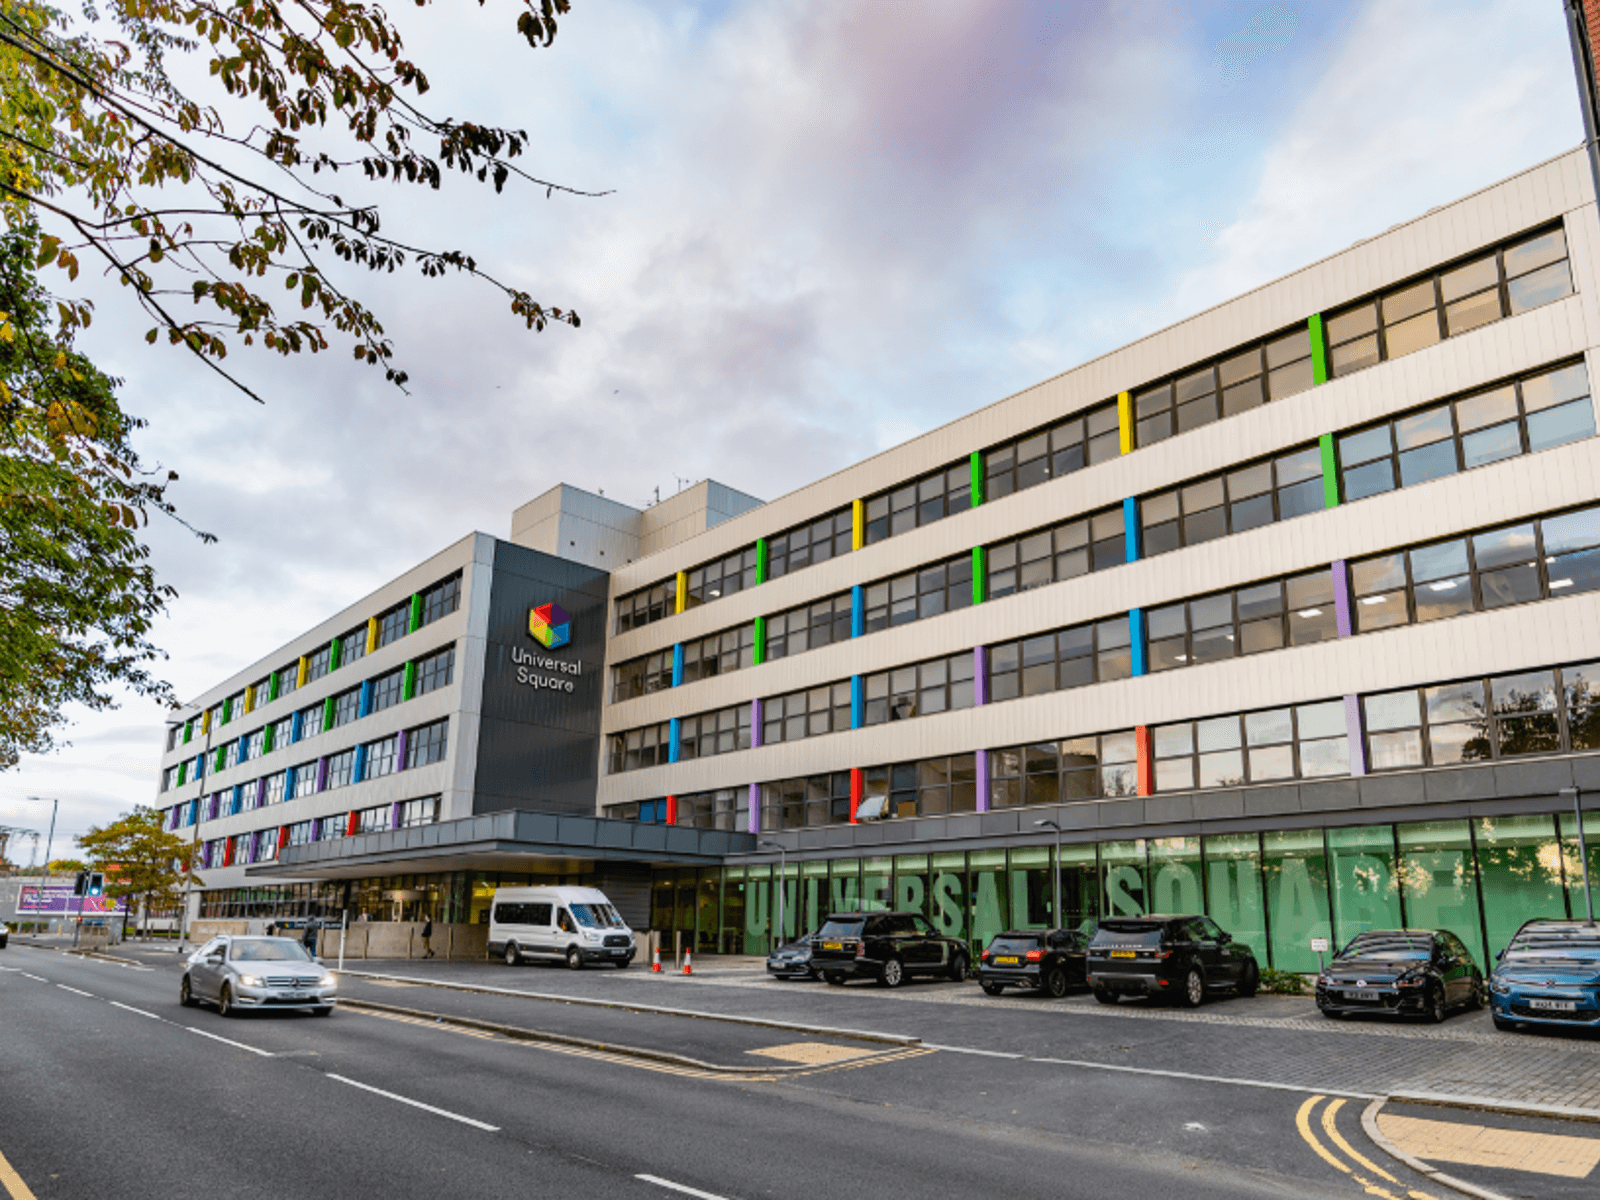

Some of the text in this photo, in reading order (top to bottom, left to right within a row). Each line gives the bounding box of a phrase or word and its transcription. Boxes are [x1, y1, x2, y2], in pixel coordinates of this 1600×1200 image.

[511, 646, 581, 675] Universal
[517, 666, 574, 693] Square
[744, 851, 1475, 945] UNIVERSAL SQUARE
